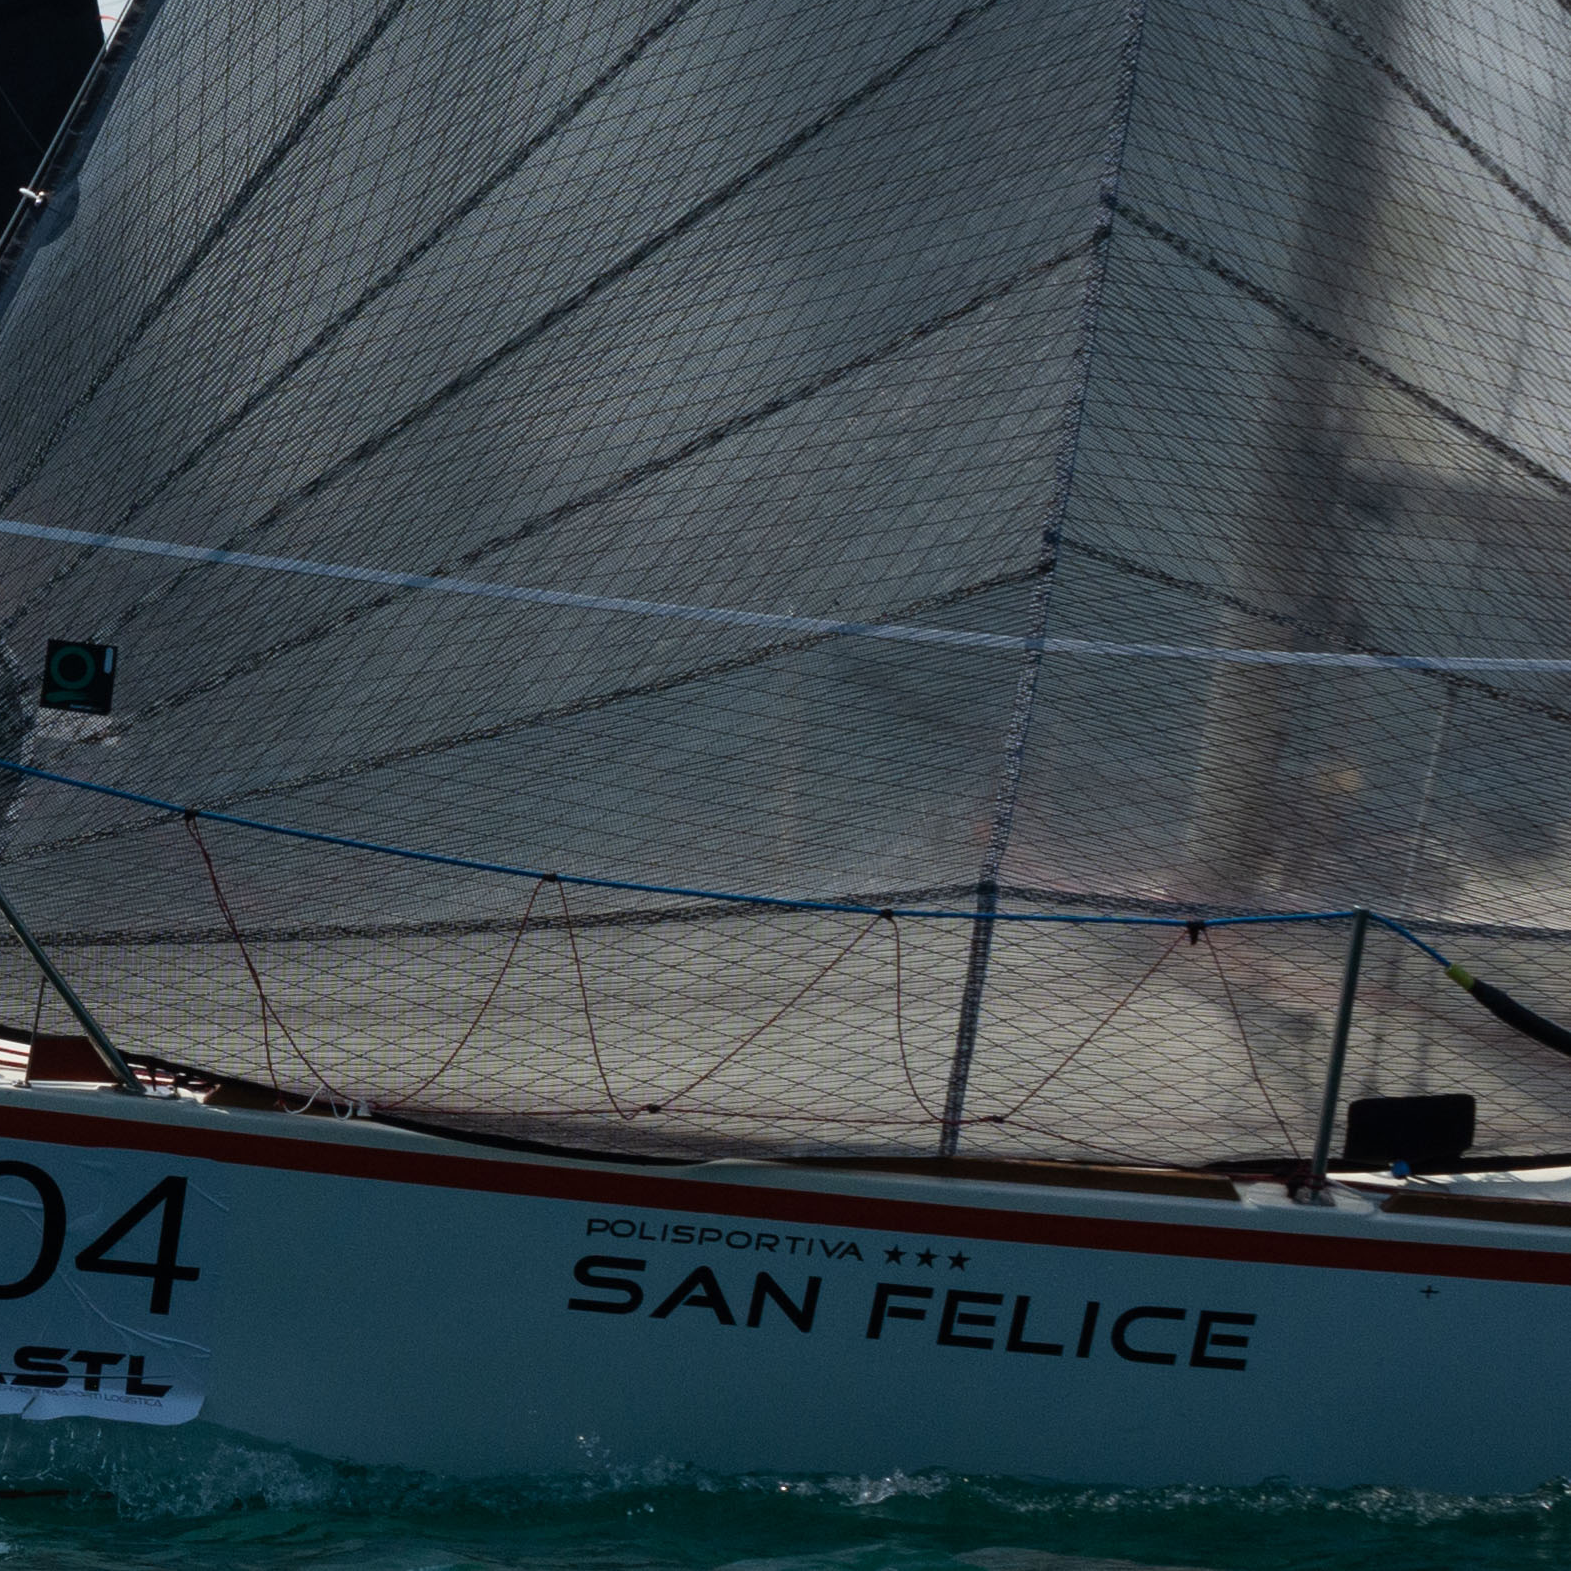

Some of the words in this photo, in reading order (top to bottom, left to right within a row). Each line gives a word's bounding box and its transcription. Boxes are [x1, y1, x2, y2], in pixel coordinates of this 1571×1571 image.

[585, 1218, 865, 1262] POLISPORTIVA
[566, 1253, 823, 1334] SAN
[865, 1281, 1259, 1373] FELICE
